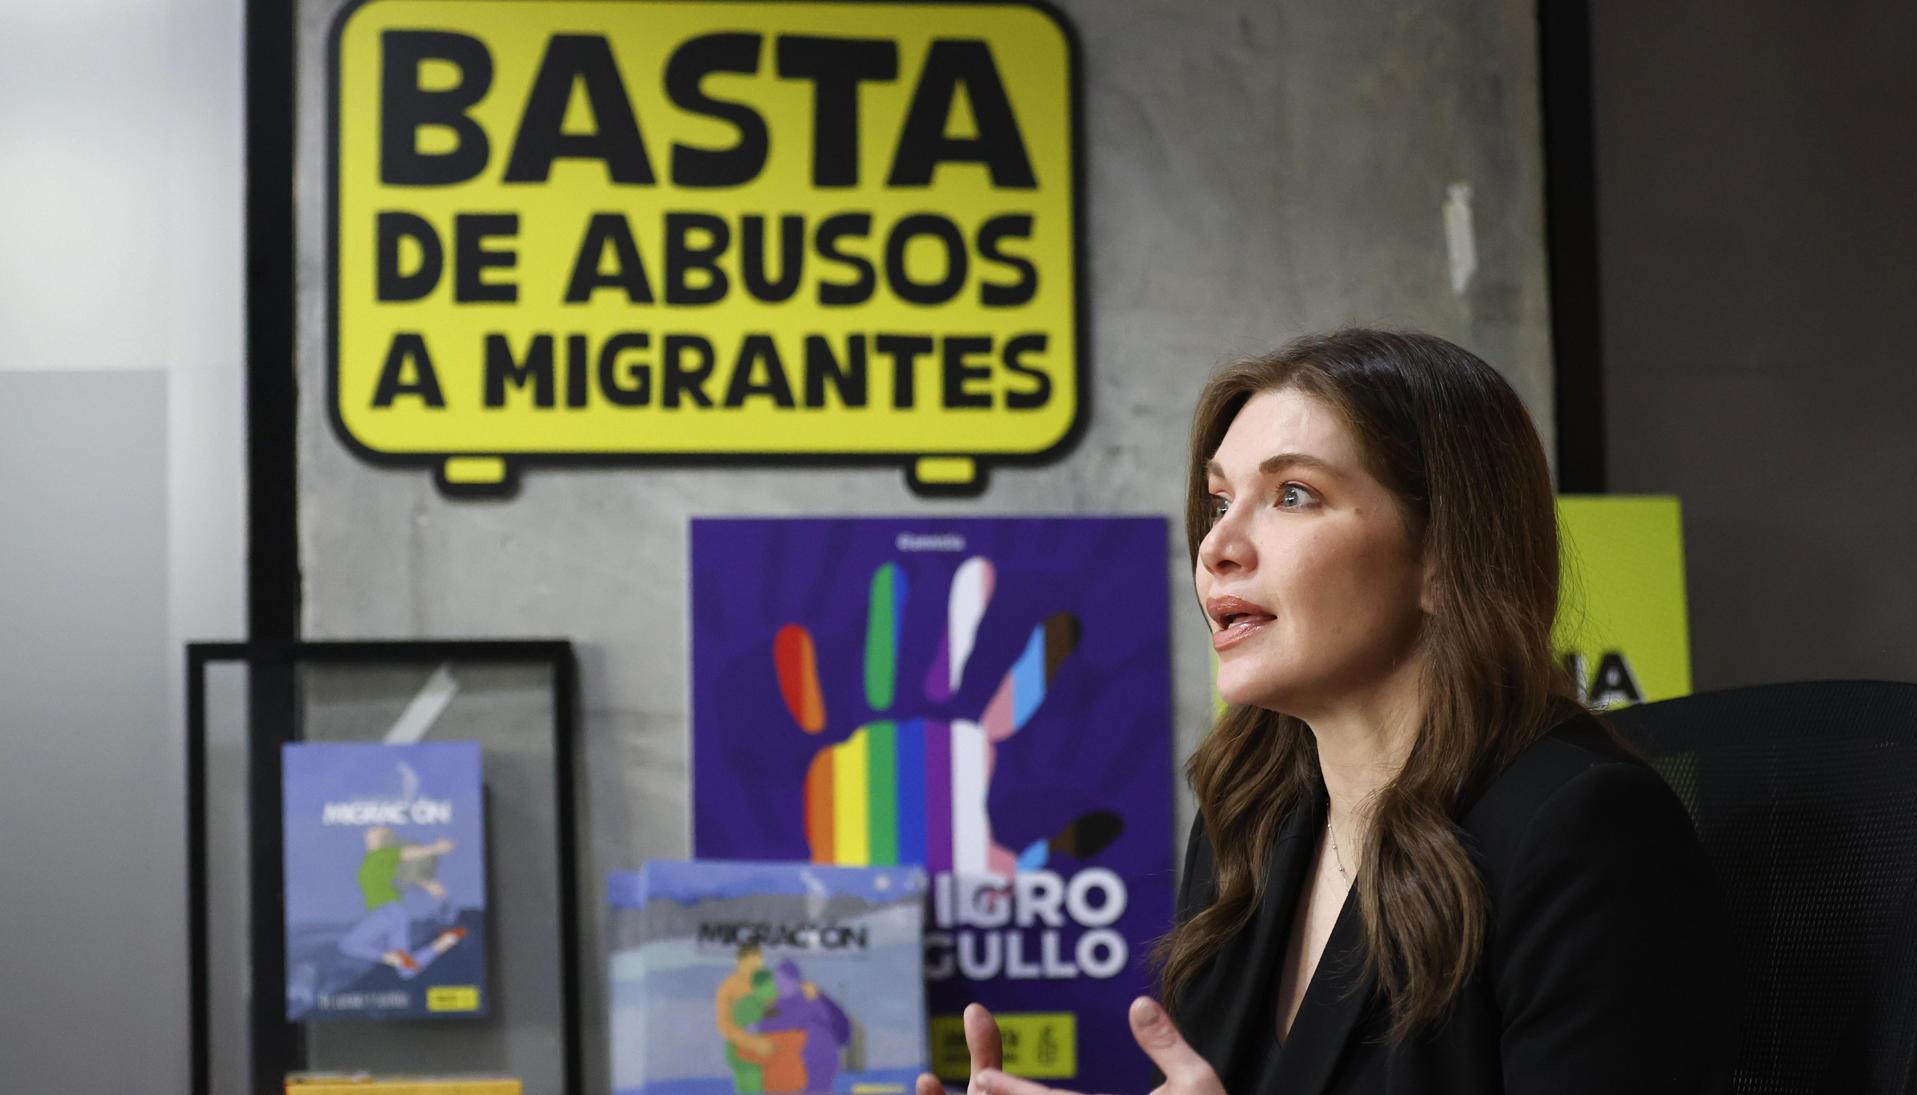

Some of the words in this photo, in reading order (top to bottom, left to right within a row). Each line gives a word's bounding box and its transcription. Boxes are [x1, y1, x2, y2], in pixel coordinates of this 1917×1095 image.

[379, 28, 1040, 192] BASTA
[375, 210, 520, 305] DE
[563, 210, 1040, 309] ABUSOS
[370, 331, 446, 409] A
[482, 331, 1053, 411] MIGRANTES
[933, 866, 1129, 929] IGRO
[922, 928, 1129, 981] GULLO
